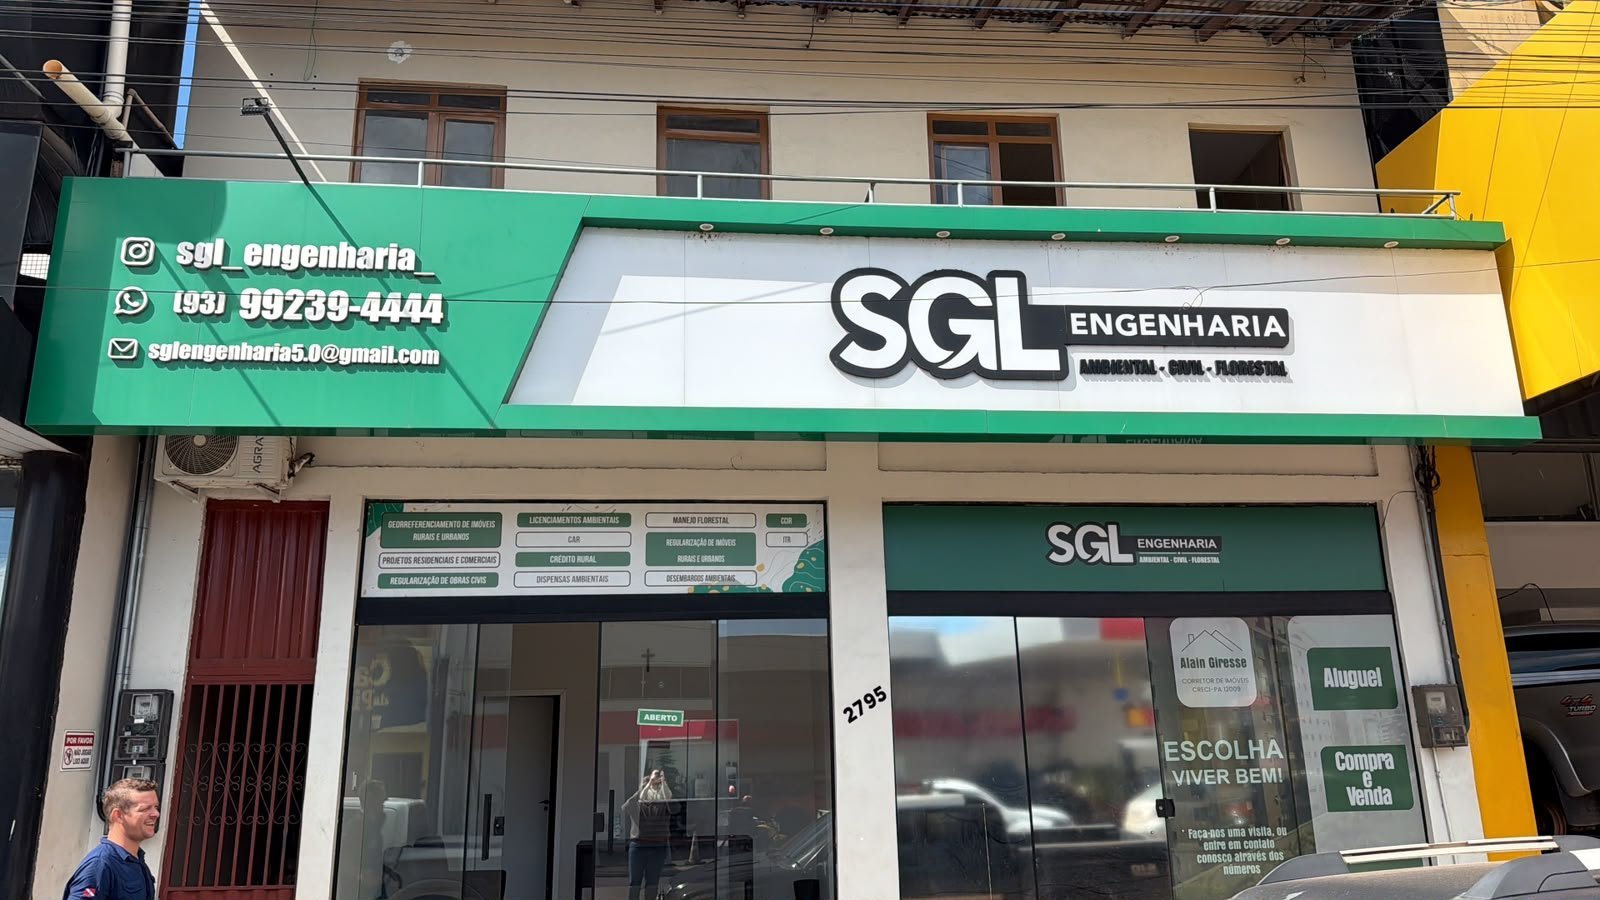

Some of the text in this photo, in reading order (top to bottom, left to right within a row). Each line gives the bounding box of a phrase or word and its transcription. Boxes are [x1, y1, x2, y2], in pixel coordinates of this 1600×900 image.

[176, 238, 435, 276] sgl_engenharia_
[173, 288, 443, 324] (93) 99239-4444
[838, 273, 1061, 371] SGL
[1070, 312, 1286, 338] ENGENHARIA
[148, 341, 440, 366] sglengenharia5.0@gmail.com
[1079, 358, 1157, 375] AMBIENTAL
[1168, 360, 1205, 376] CIVIL
[1214, 360, 1288, 377] FLORESTAL
[252, 435, 264, 473] AGRA
[388, 519, 496, 529] GEORREFERENCIAMENTO DE IMÓVEIS
[529, 516, 620, 524] LICENCIAMENTOS AMBIENTAIS
[413, 532, 470, 541] RURAIS E URBANOS
[666, 538, 736, 548] REGULARIZAÇÃO DE IMÓVEIS
[1048, 524, 1134, 563] SGL
[1137, 538, 1217, 548] ENGENHARIA
[382, 556, 496, 565] PROJETOS RESIDENCIAIS E COMERCIAIS
[550, 554, 596, 564] CRÉDITO RURAL
[678, 554, 725, 562] RURAIS E URBANOS
[390, 576, 486, 586] REGULARIZAÇÃO DE OBRAS CIVIS
[536, 576, 608, 584] DISPENSAS AMBIENTAIS
[666, 574, 736, 582] DESEMBARGOS AMBIENTAIS
[1180, 657, 1247, 668] Alain Giresse
[1323, 667, 1382, 689] Aluguel
[843, 686, 887, 724] 2795
[644, 714, 678, 722] ABERTO
[1164, 739, 1284, 762] ESCOLHA
[1335, 752, 1394, 772] Compra
[1172, 768, 1283, 786] VIVER BEM!
[1362, 772, 1372, 788] e
[1346, 786, 1392, 806] Venda
[1188, 826, 1288, 840] Faça-nos uma visita, ou
[1204, 838, 1274, 850] entre em contato
[1196, 850, 1284, 864] conosco através dos
[1224, 864, 1260, 874] números
